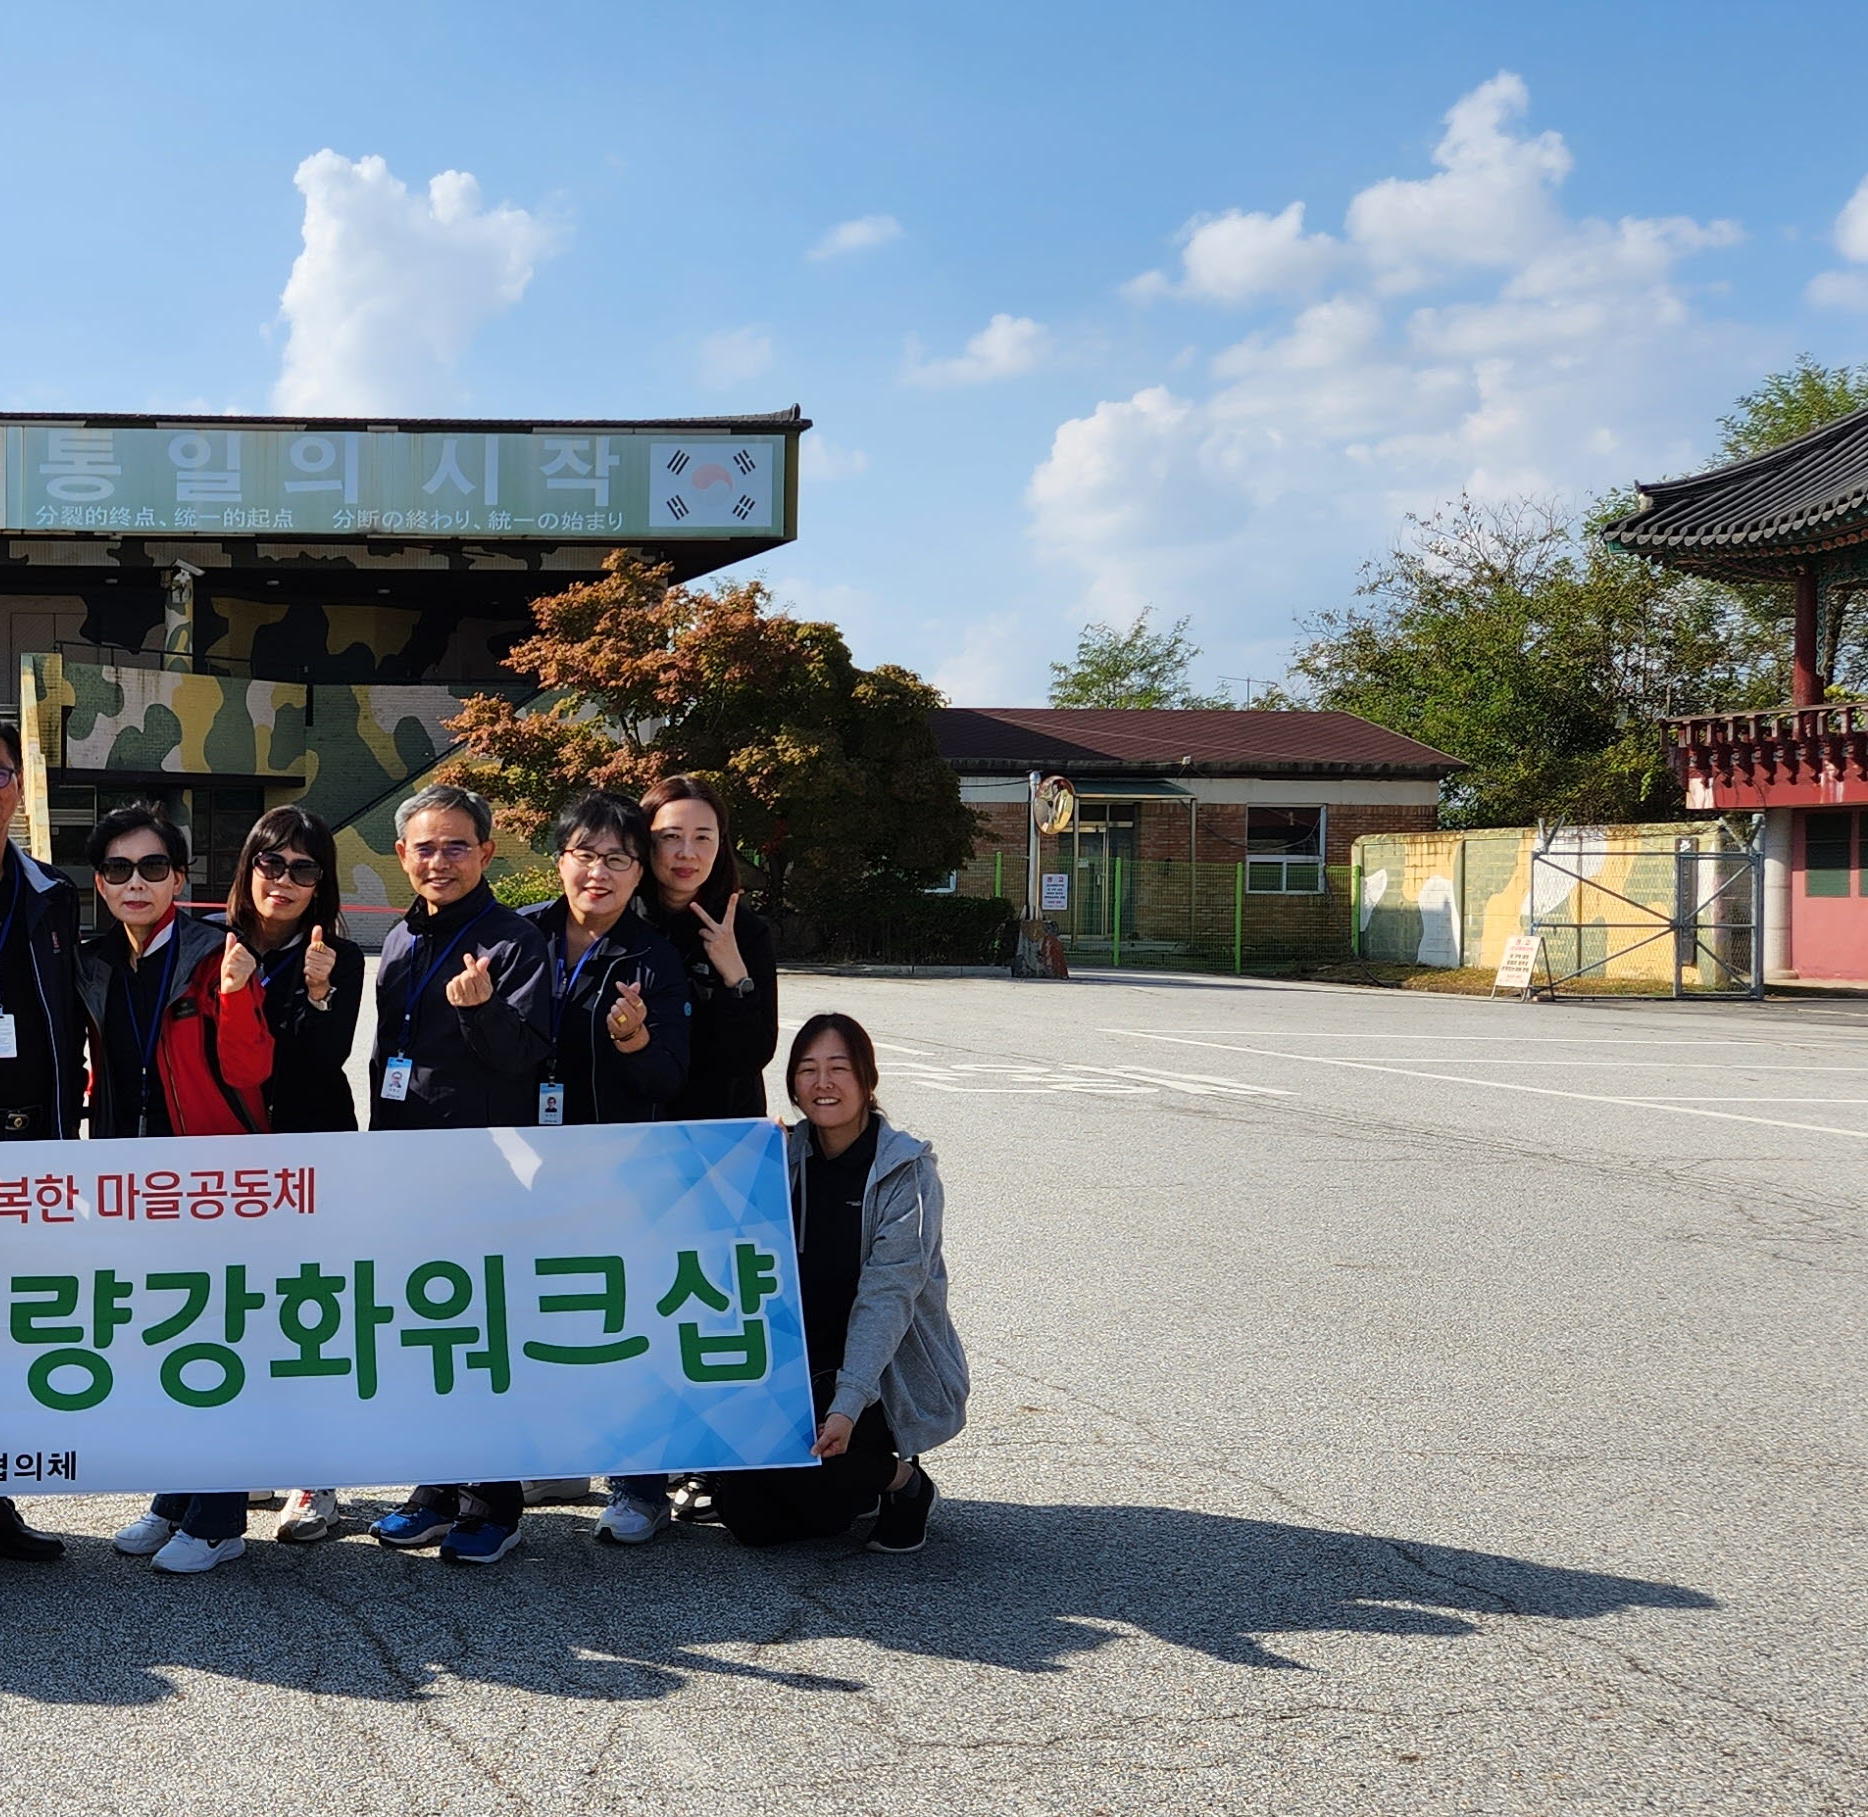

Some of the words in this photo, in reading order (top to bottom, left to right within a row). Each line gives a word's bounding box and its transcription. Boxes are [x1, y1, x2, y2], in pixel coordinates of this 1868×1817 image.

[39, 430, 358, 505] 통일의
[422, 434, 621, 507] 시작
[332, 508, 624, 532] 分断の終わり、統一の始まり
[96, 1166, 315, 1221] 마을공동체
